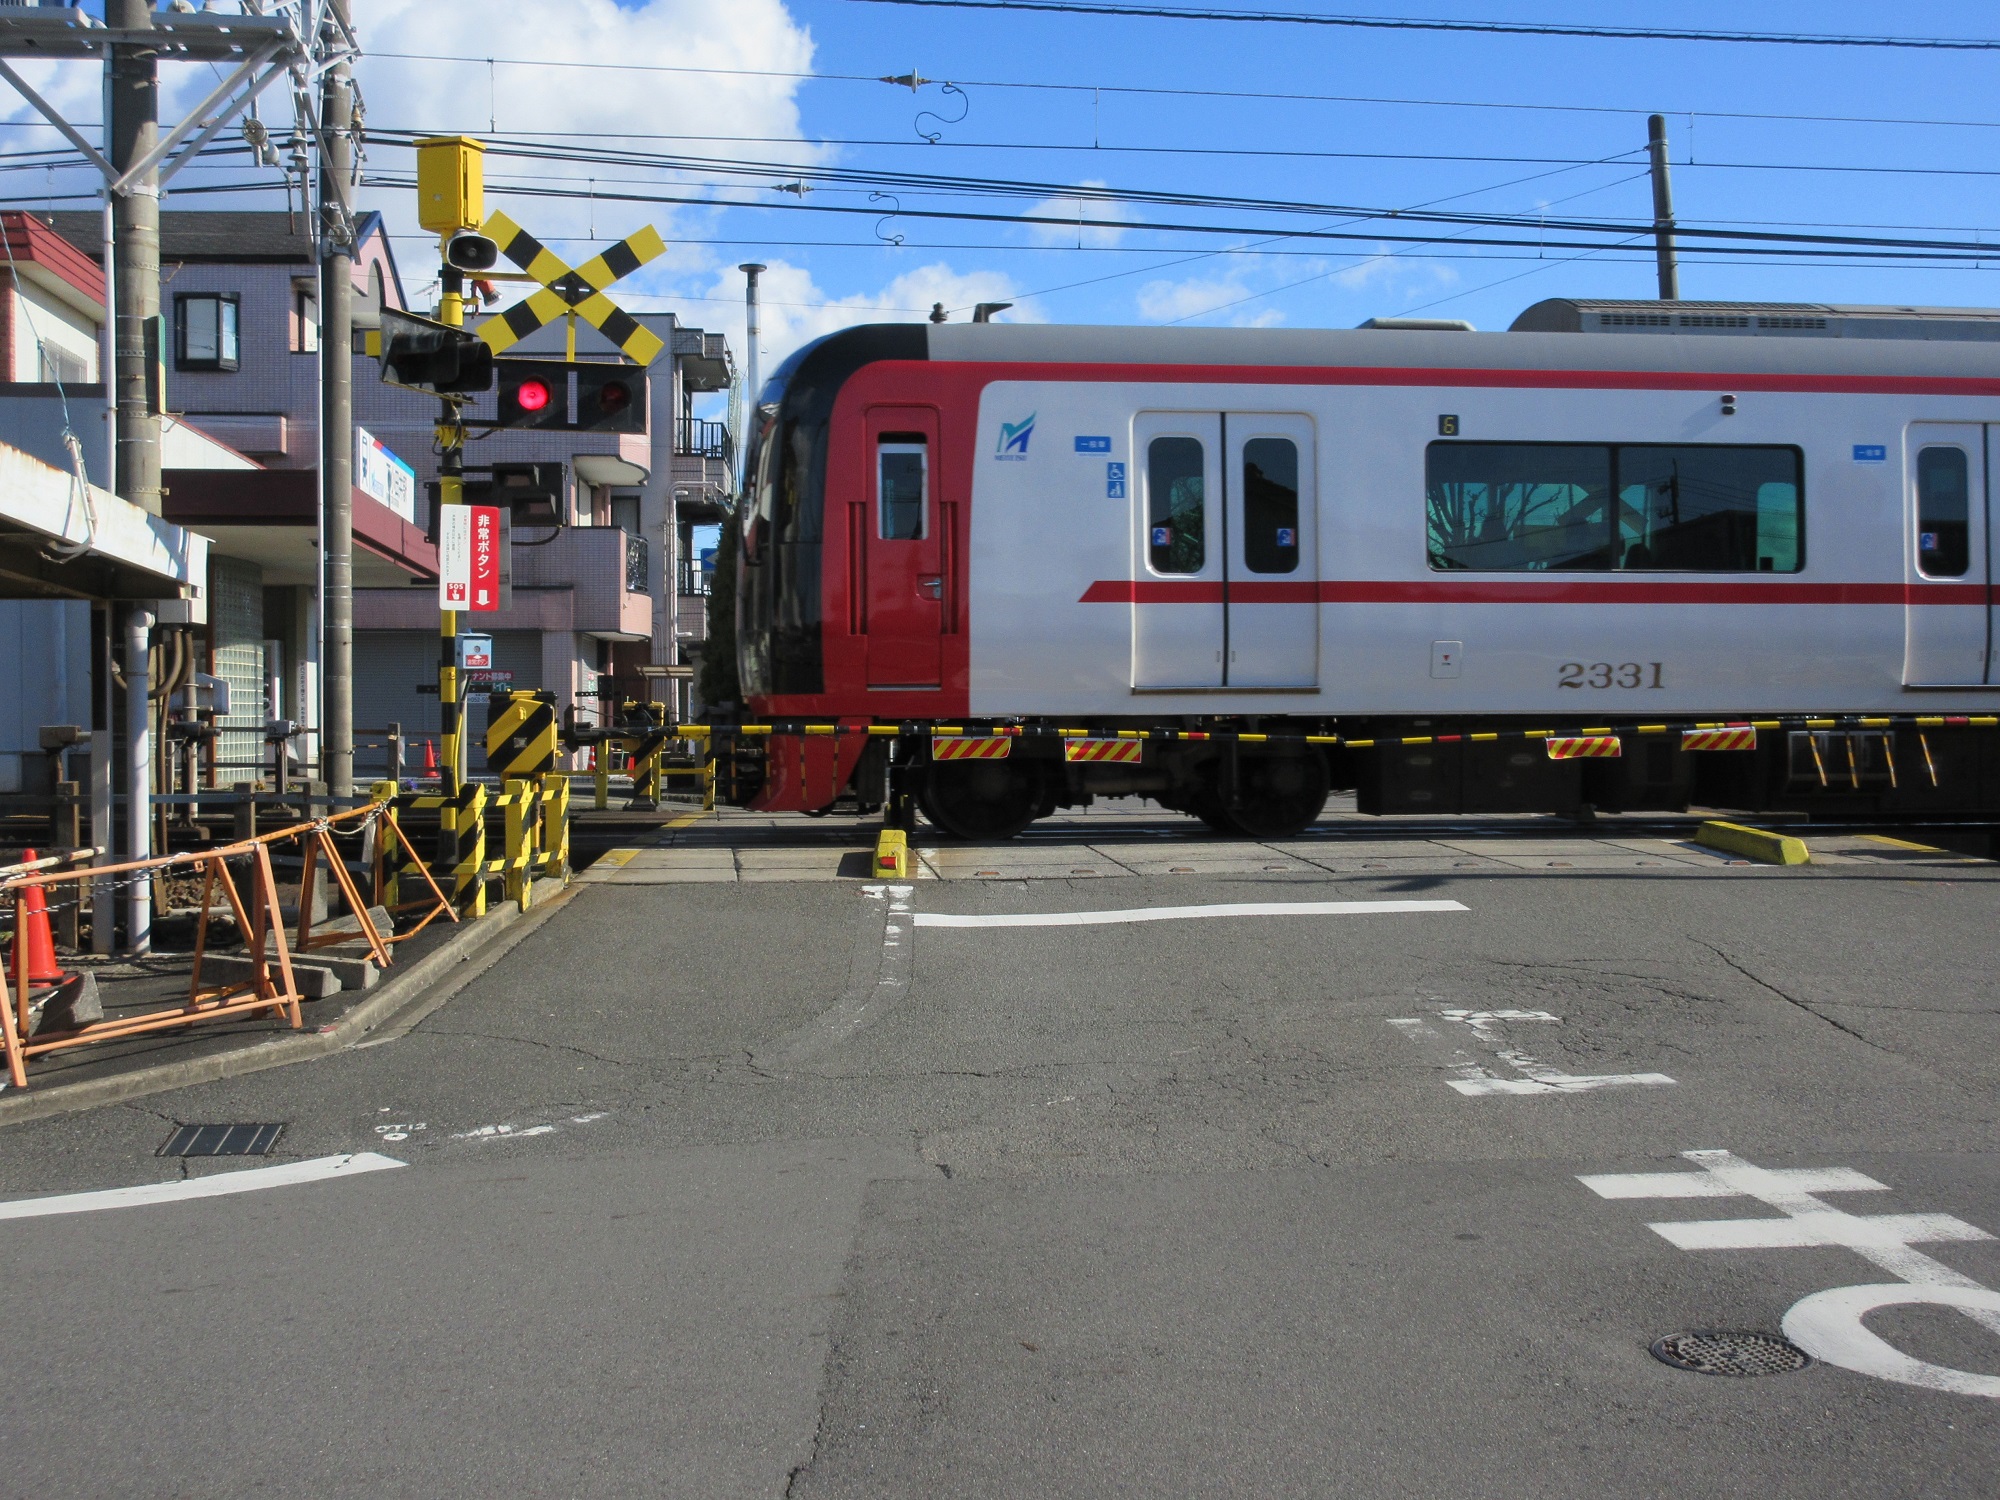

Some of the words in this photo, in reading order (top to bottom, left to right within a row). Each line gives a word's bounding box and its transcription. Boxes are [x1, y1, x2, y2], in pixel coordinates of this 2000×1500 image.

[1443, 416, 1455, 434] 6
[477, 514, 490, 579] 非常ボタン
[472, 672, 512, 681] ナント募集中
[1558, 662, 1666, 689] 2331
